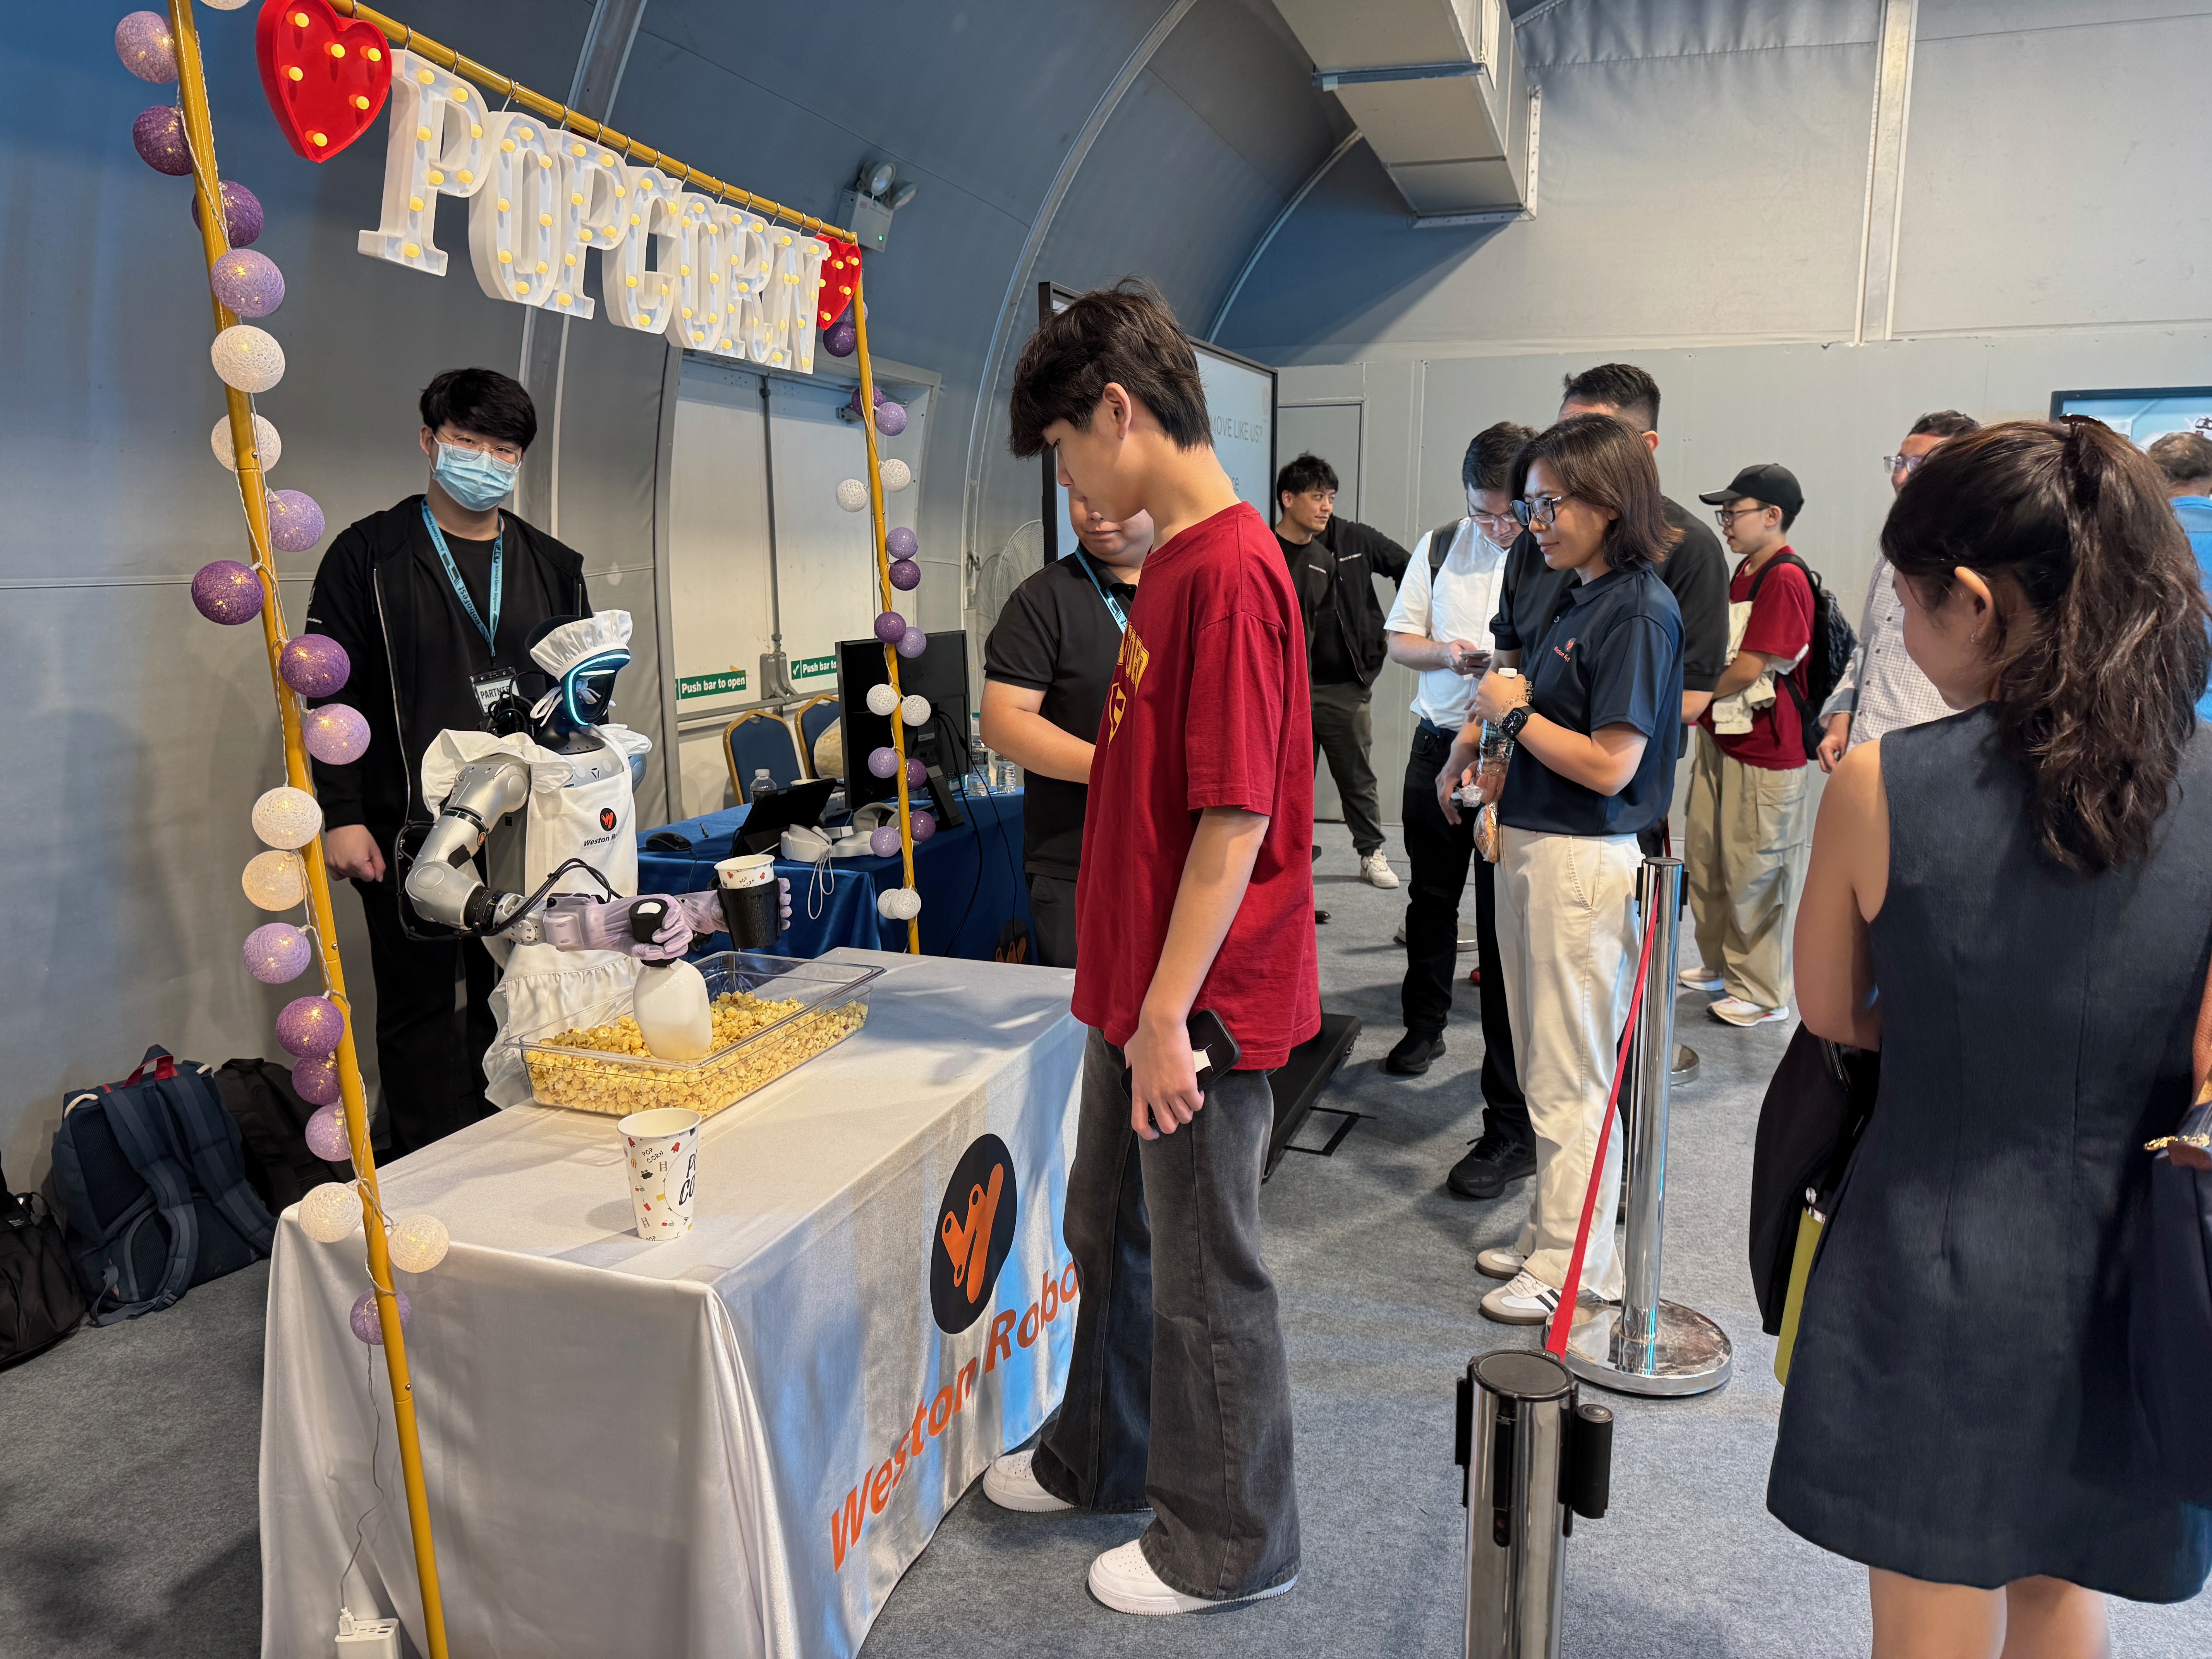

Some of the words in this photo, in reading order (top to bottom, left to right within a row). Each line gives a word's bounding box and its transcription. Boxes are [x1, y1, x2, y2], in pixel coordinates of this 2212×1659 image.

[358, 49, 828, 374] POPCORN
[1211, 415, 1232, 438] MOVE
[1234, 419, 1249, 441] LIKE
[1250, 424, 1262, 443] US?
[458, 585, 481, 625] RoboFest
[803, 663, 818, 674] Push
[819, 661, 830, 671] bar
[830, 660, 836, 670] to
[682, 681, 701, 694] Push
[703, 679, 716, 691] bar
[718, 678, 726, 688] to
[727, 677, 745, 689] open
[584, 836, 610, 847] Weston
[642, 1148, 653, 1157] POP
[646, 1151, 664, 1163] CORN
[831, 1356, 977, 1572] Weston
[985, 1260, 1079, 1374] Robo
